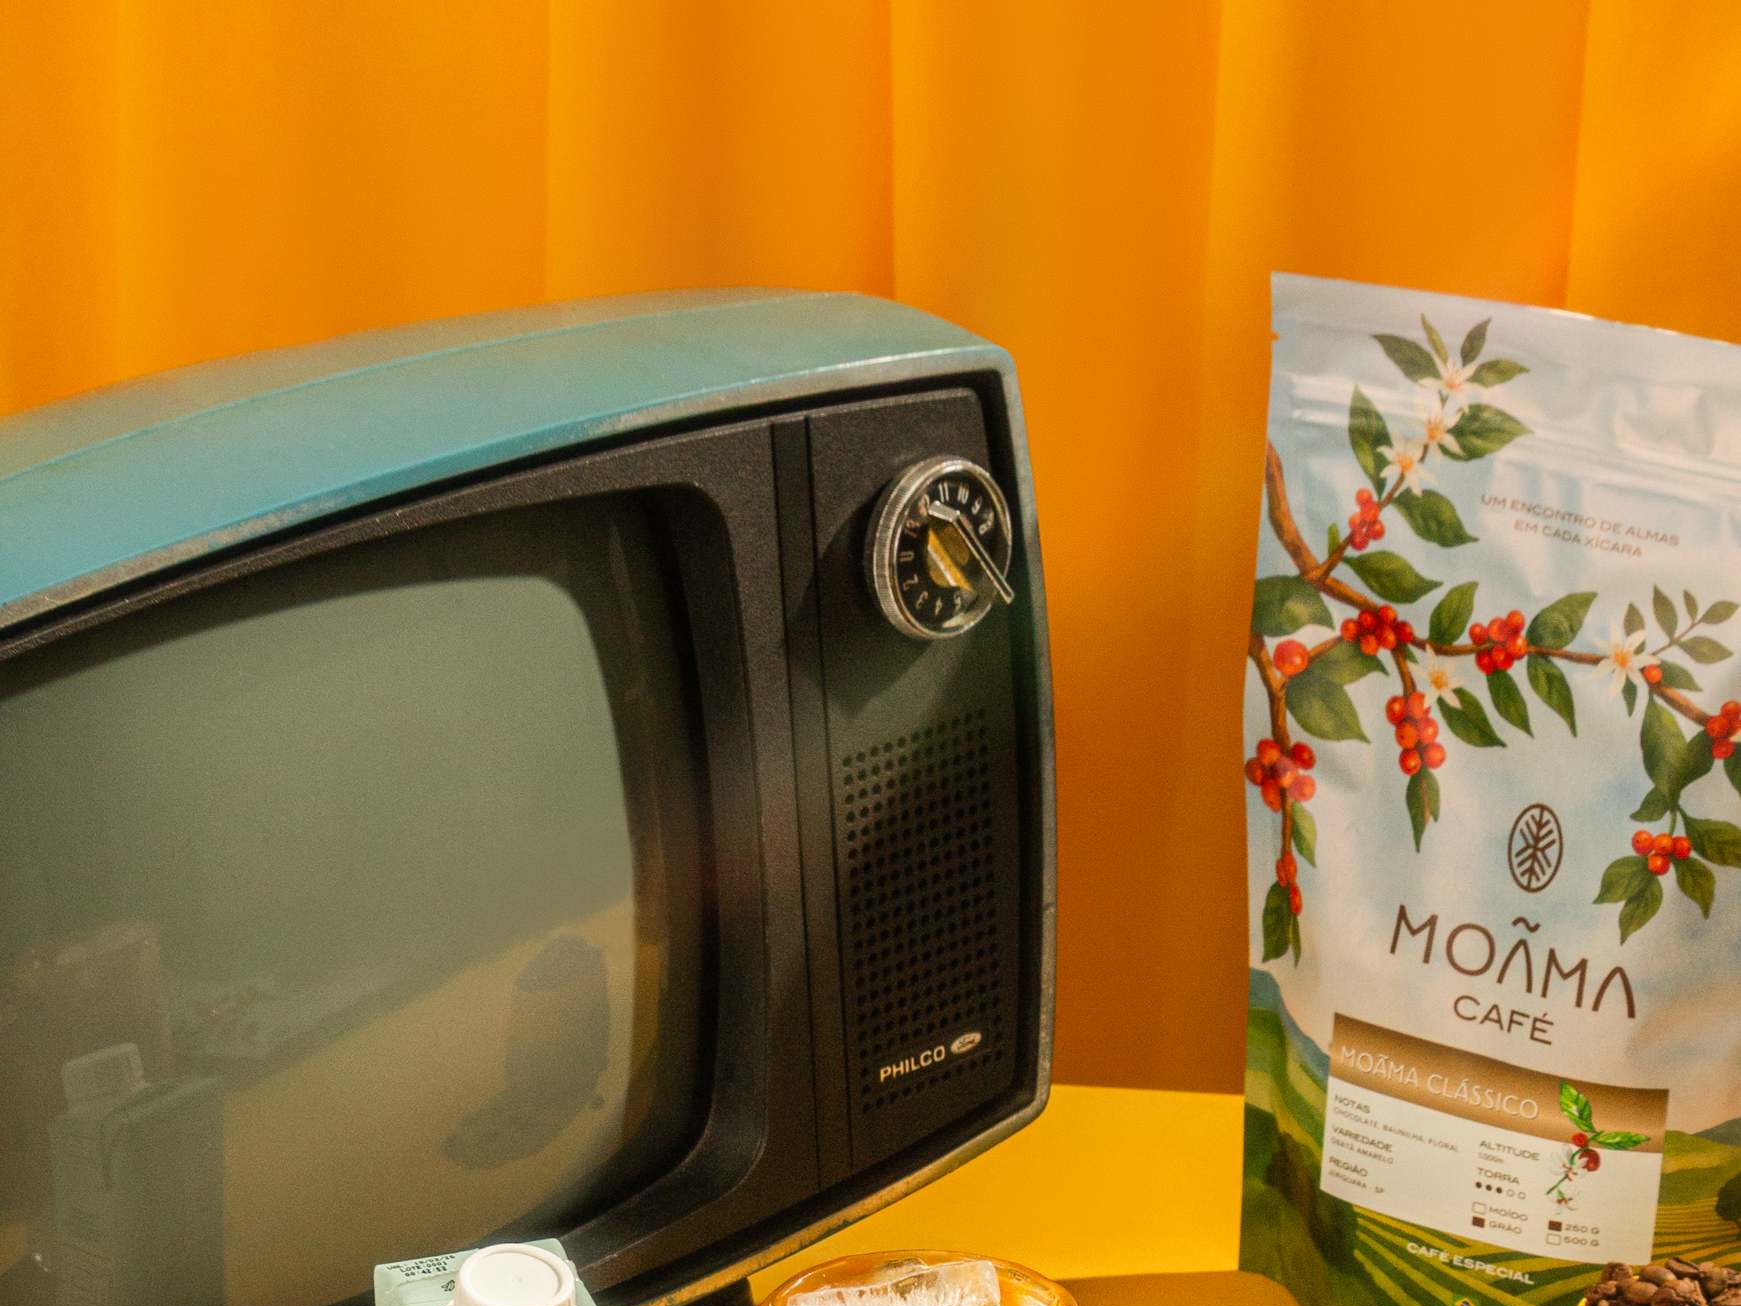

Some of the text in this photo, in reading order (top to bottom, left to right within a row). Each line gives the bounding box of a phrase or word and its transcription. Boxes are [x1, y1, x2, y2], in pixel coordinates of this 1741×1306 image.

[938, 482, 949, 502] 11
[958, 484, 969, 504] 10
[972, 497, 983, 514] 9
[1481, 494, 1681, 547] UM ENCONTRO DE ALMAS
[1514, 519, 1539, 534] EM
[1542, 525, 1581, 544] CADA
[1390, 904, 1636, 1019] MOÃMA
[1453, 995, 1554, 1046] CAFÉ
[879, 1045, 946, 1083] PHILCO
[1335, 1095, 1370, 1114] NOTAS
[1427, 1074, 1538, 1119] CLÁSSICO
[1332, 1126, 1392, 1153] VARIEDADE
[1479, 1140, 1540, 1161] ALTITUDE
[1477, 1167, 1520, 1184] TORRA
[1564, 1236, 1589, 1246] 500
[1406, 1242, 1535, 1285] CAFÉ ESPECIAL
